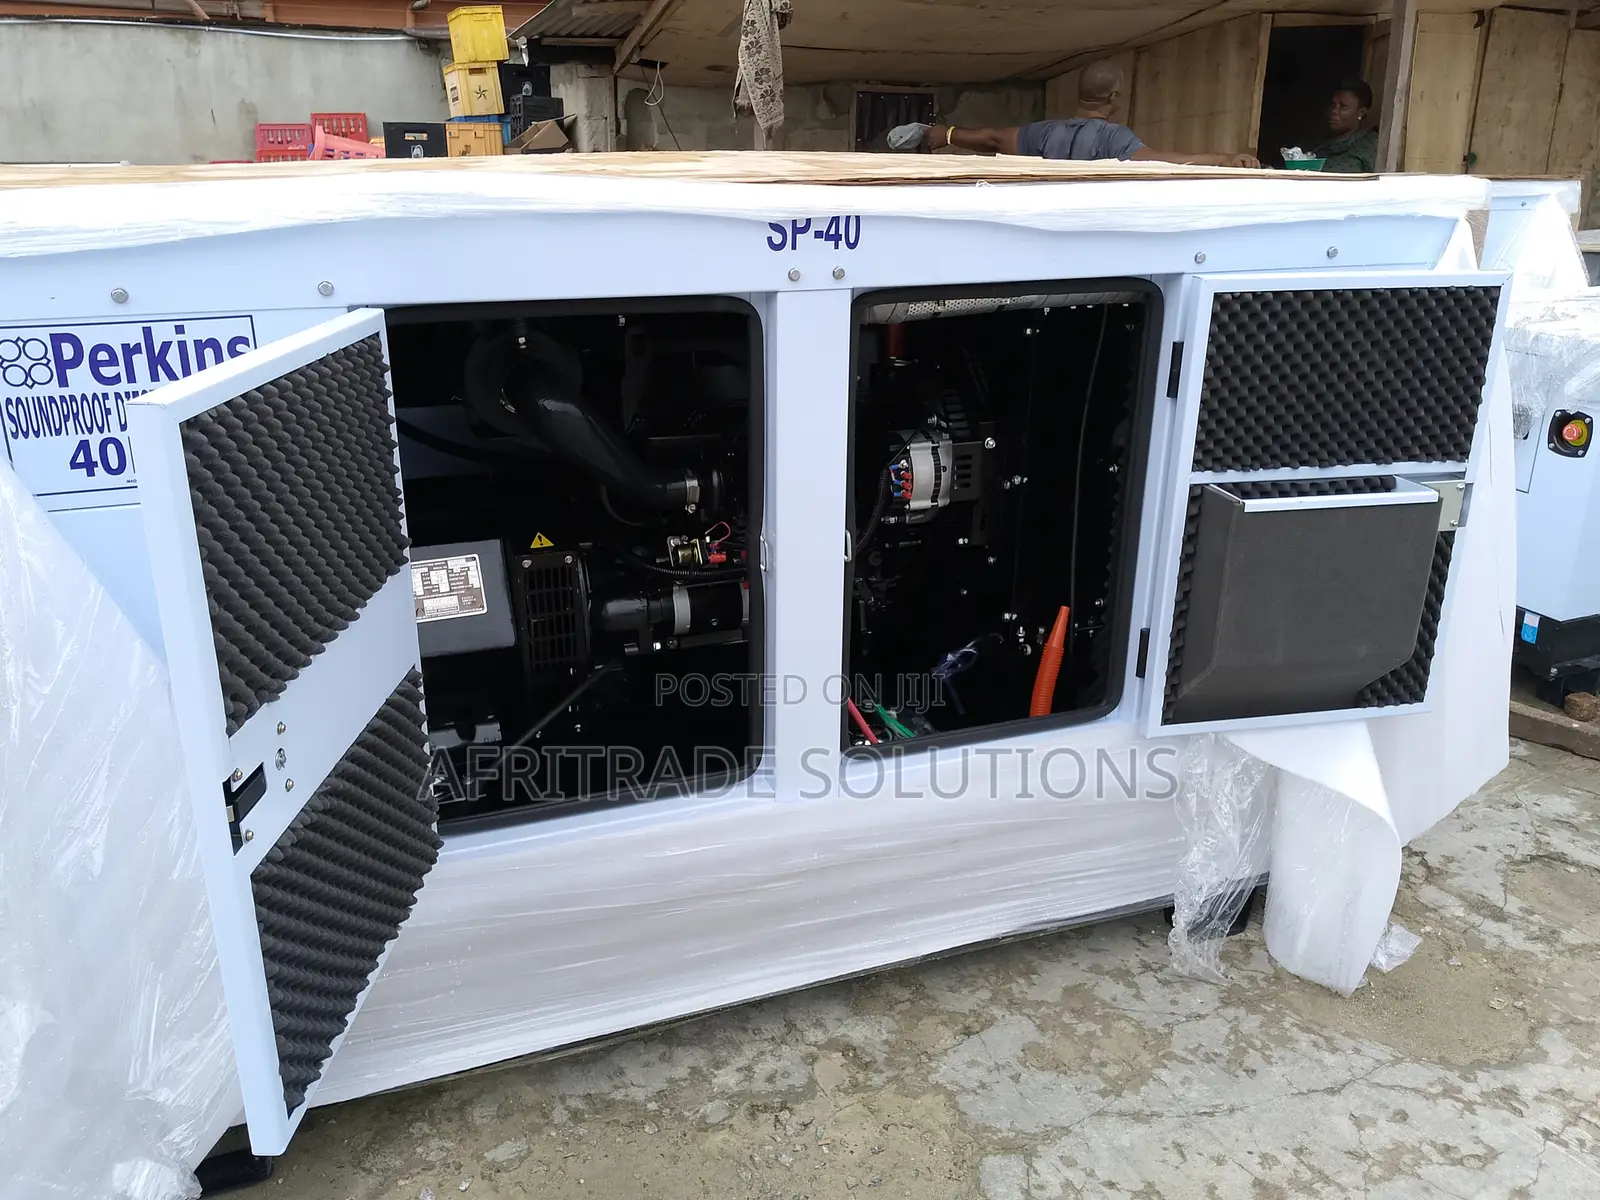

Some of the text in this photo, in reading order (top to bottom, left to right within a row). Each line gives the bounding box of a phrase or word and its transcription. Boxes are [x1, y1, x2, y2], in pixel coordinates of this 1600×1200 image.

[766, 214, 861, 251] SP-40
[5, 390, 112, 440] SOUNDPROOF
[69, 436, 128, 477] 40
